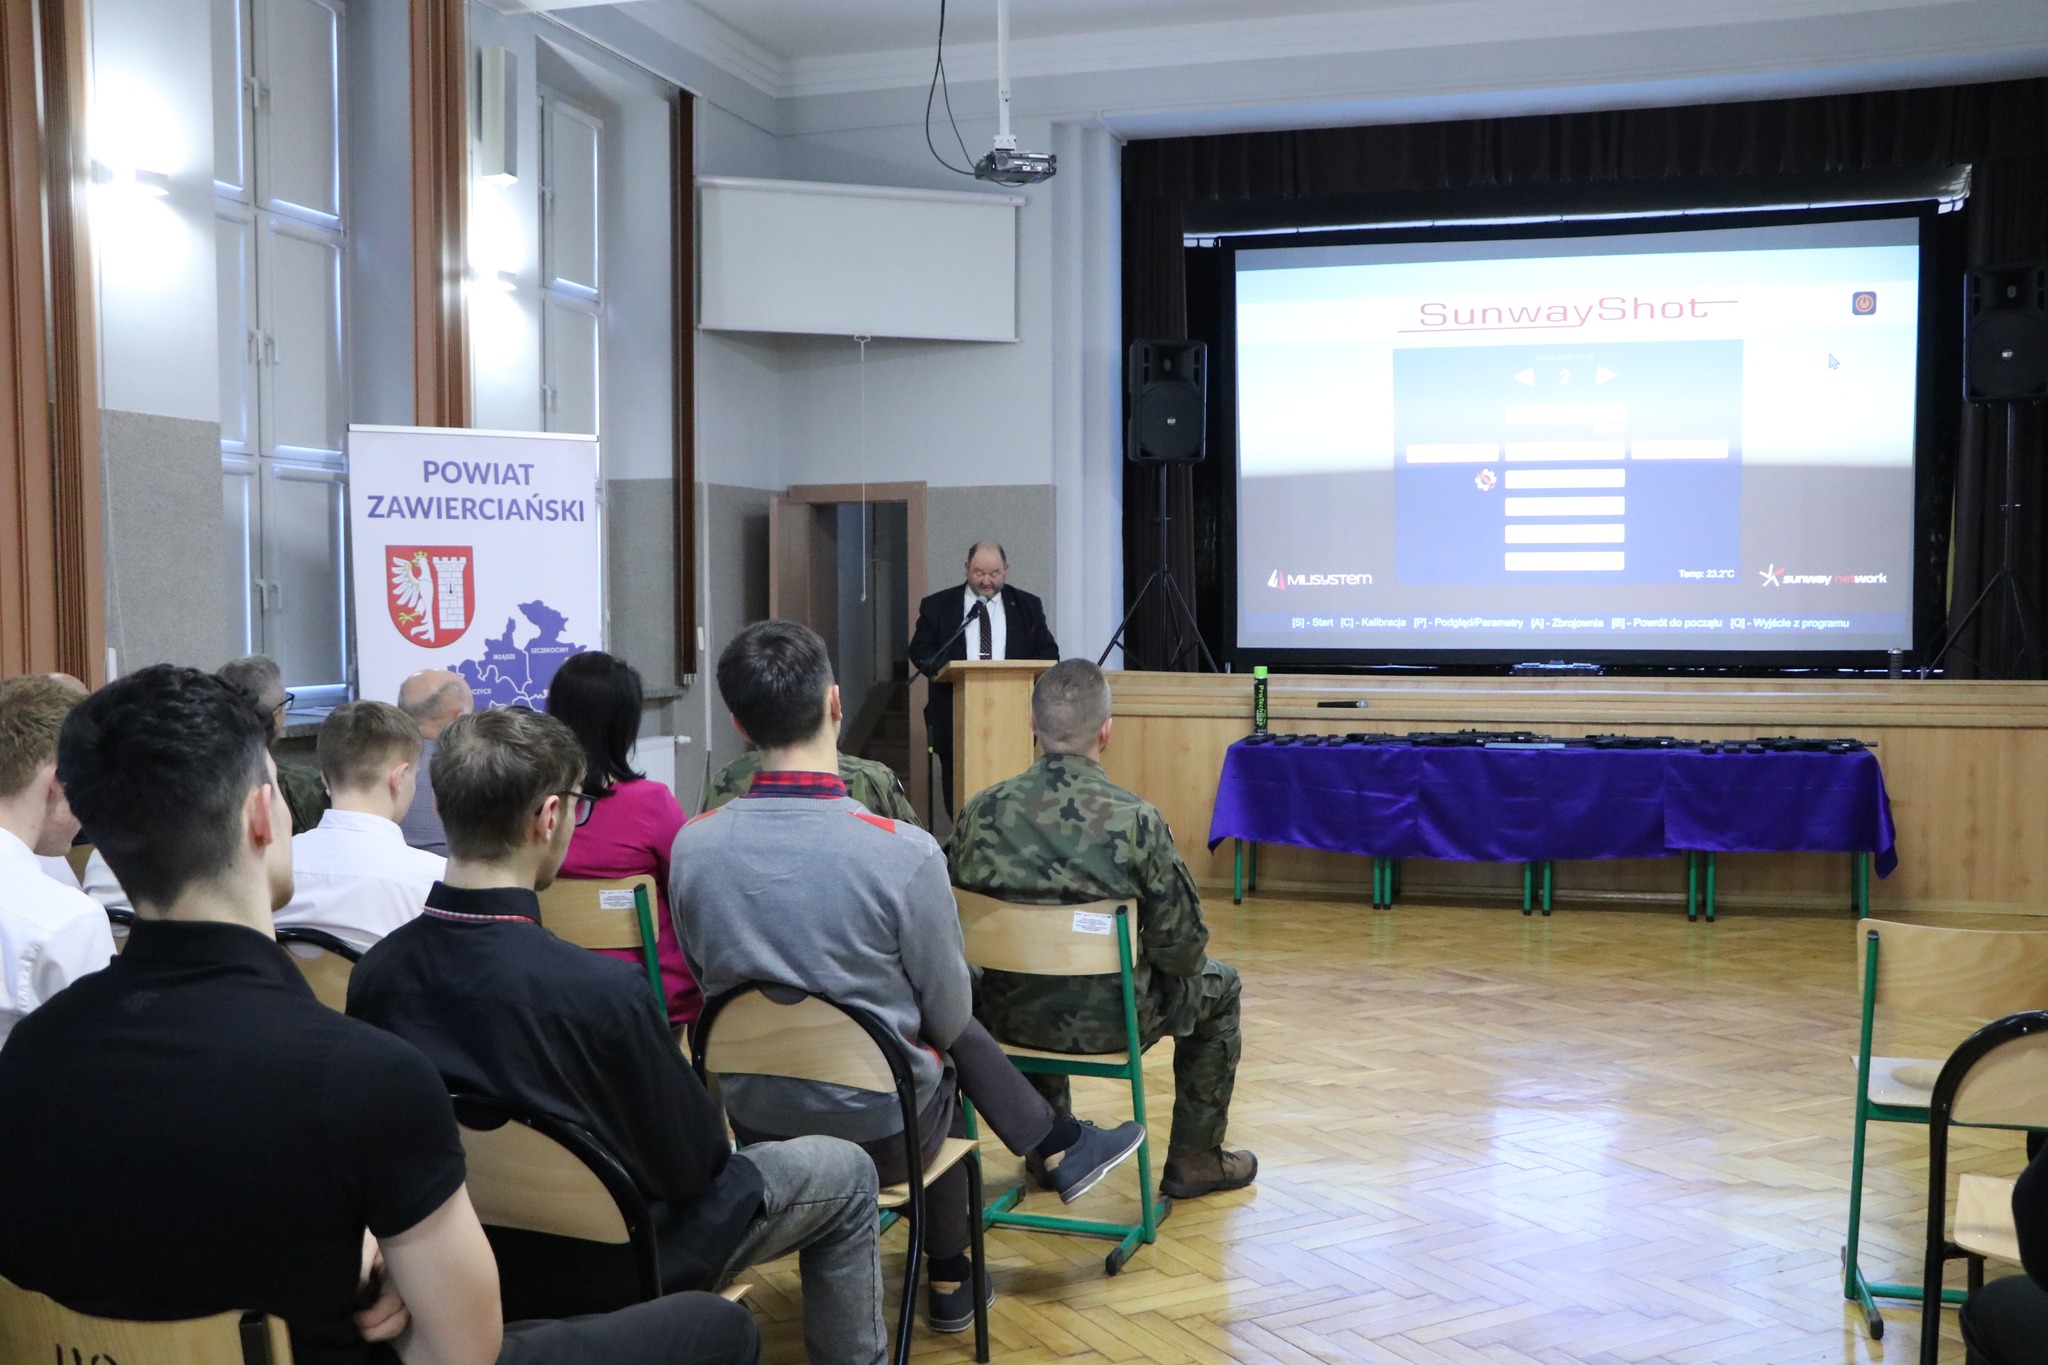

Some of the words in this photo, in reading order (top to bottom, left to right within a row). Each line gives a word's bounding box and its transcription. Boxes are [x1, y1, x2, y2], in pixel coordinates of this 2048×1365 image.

[1420, 297, 1709, 328] SunwayShot
[423, 460, 534, 485] POWIAT
[367, 493, 585, 522] ZAWIERCIAŃSKI
[1679, 569, 1704, 580] Temp:
[1292, 617, 1304, 628] [S]
[1312, 617, 1334, 627] Start
[1340, 617, 1354, 628] [C]
[1361, 617, 1406, 628] Kalibracja
[1413, 617, 1427, 628] [P]
[1530, 617, 1545, 629] [A]
[1611, 617, 1625, 629] [B]
[1633, 617, 1668, 627] Powrót
[1669, 617, 1683, 627] do
[1730, 617, 1745, 629] [Q]
[1801, 620, 1850, 629] programu
